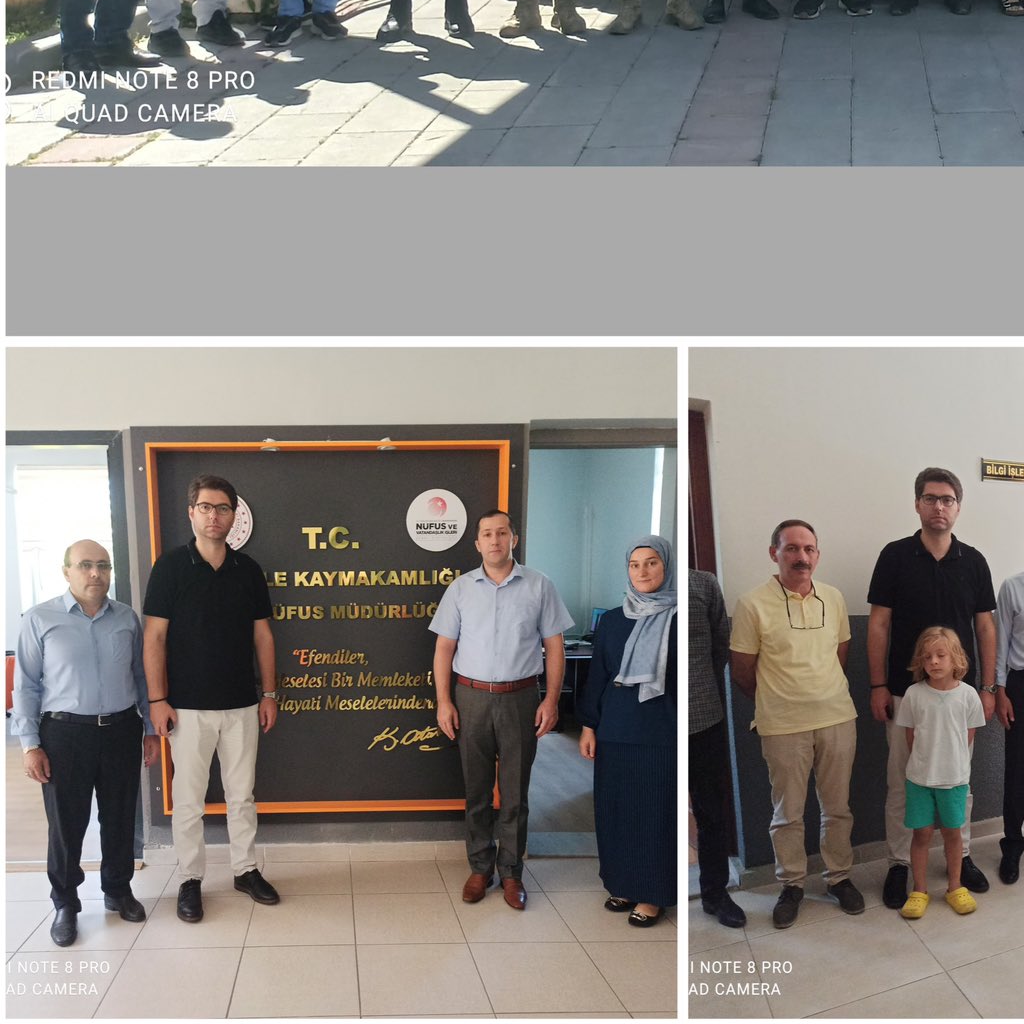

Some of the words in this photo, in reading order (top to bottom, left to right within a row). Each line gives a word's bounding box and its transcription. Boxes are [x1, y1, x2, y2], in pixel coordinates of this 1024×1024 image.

[301, 526, 360, 550] T.C.
[273, 603, 325, 620] ÜFUS
[280, 671, 328, 688] eselesi
[331, 671, 354, 688] Bir
